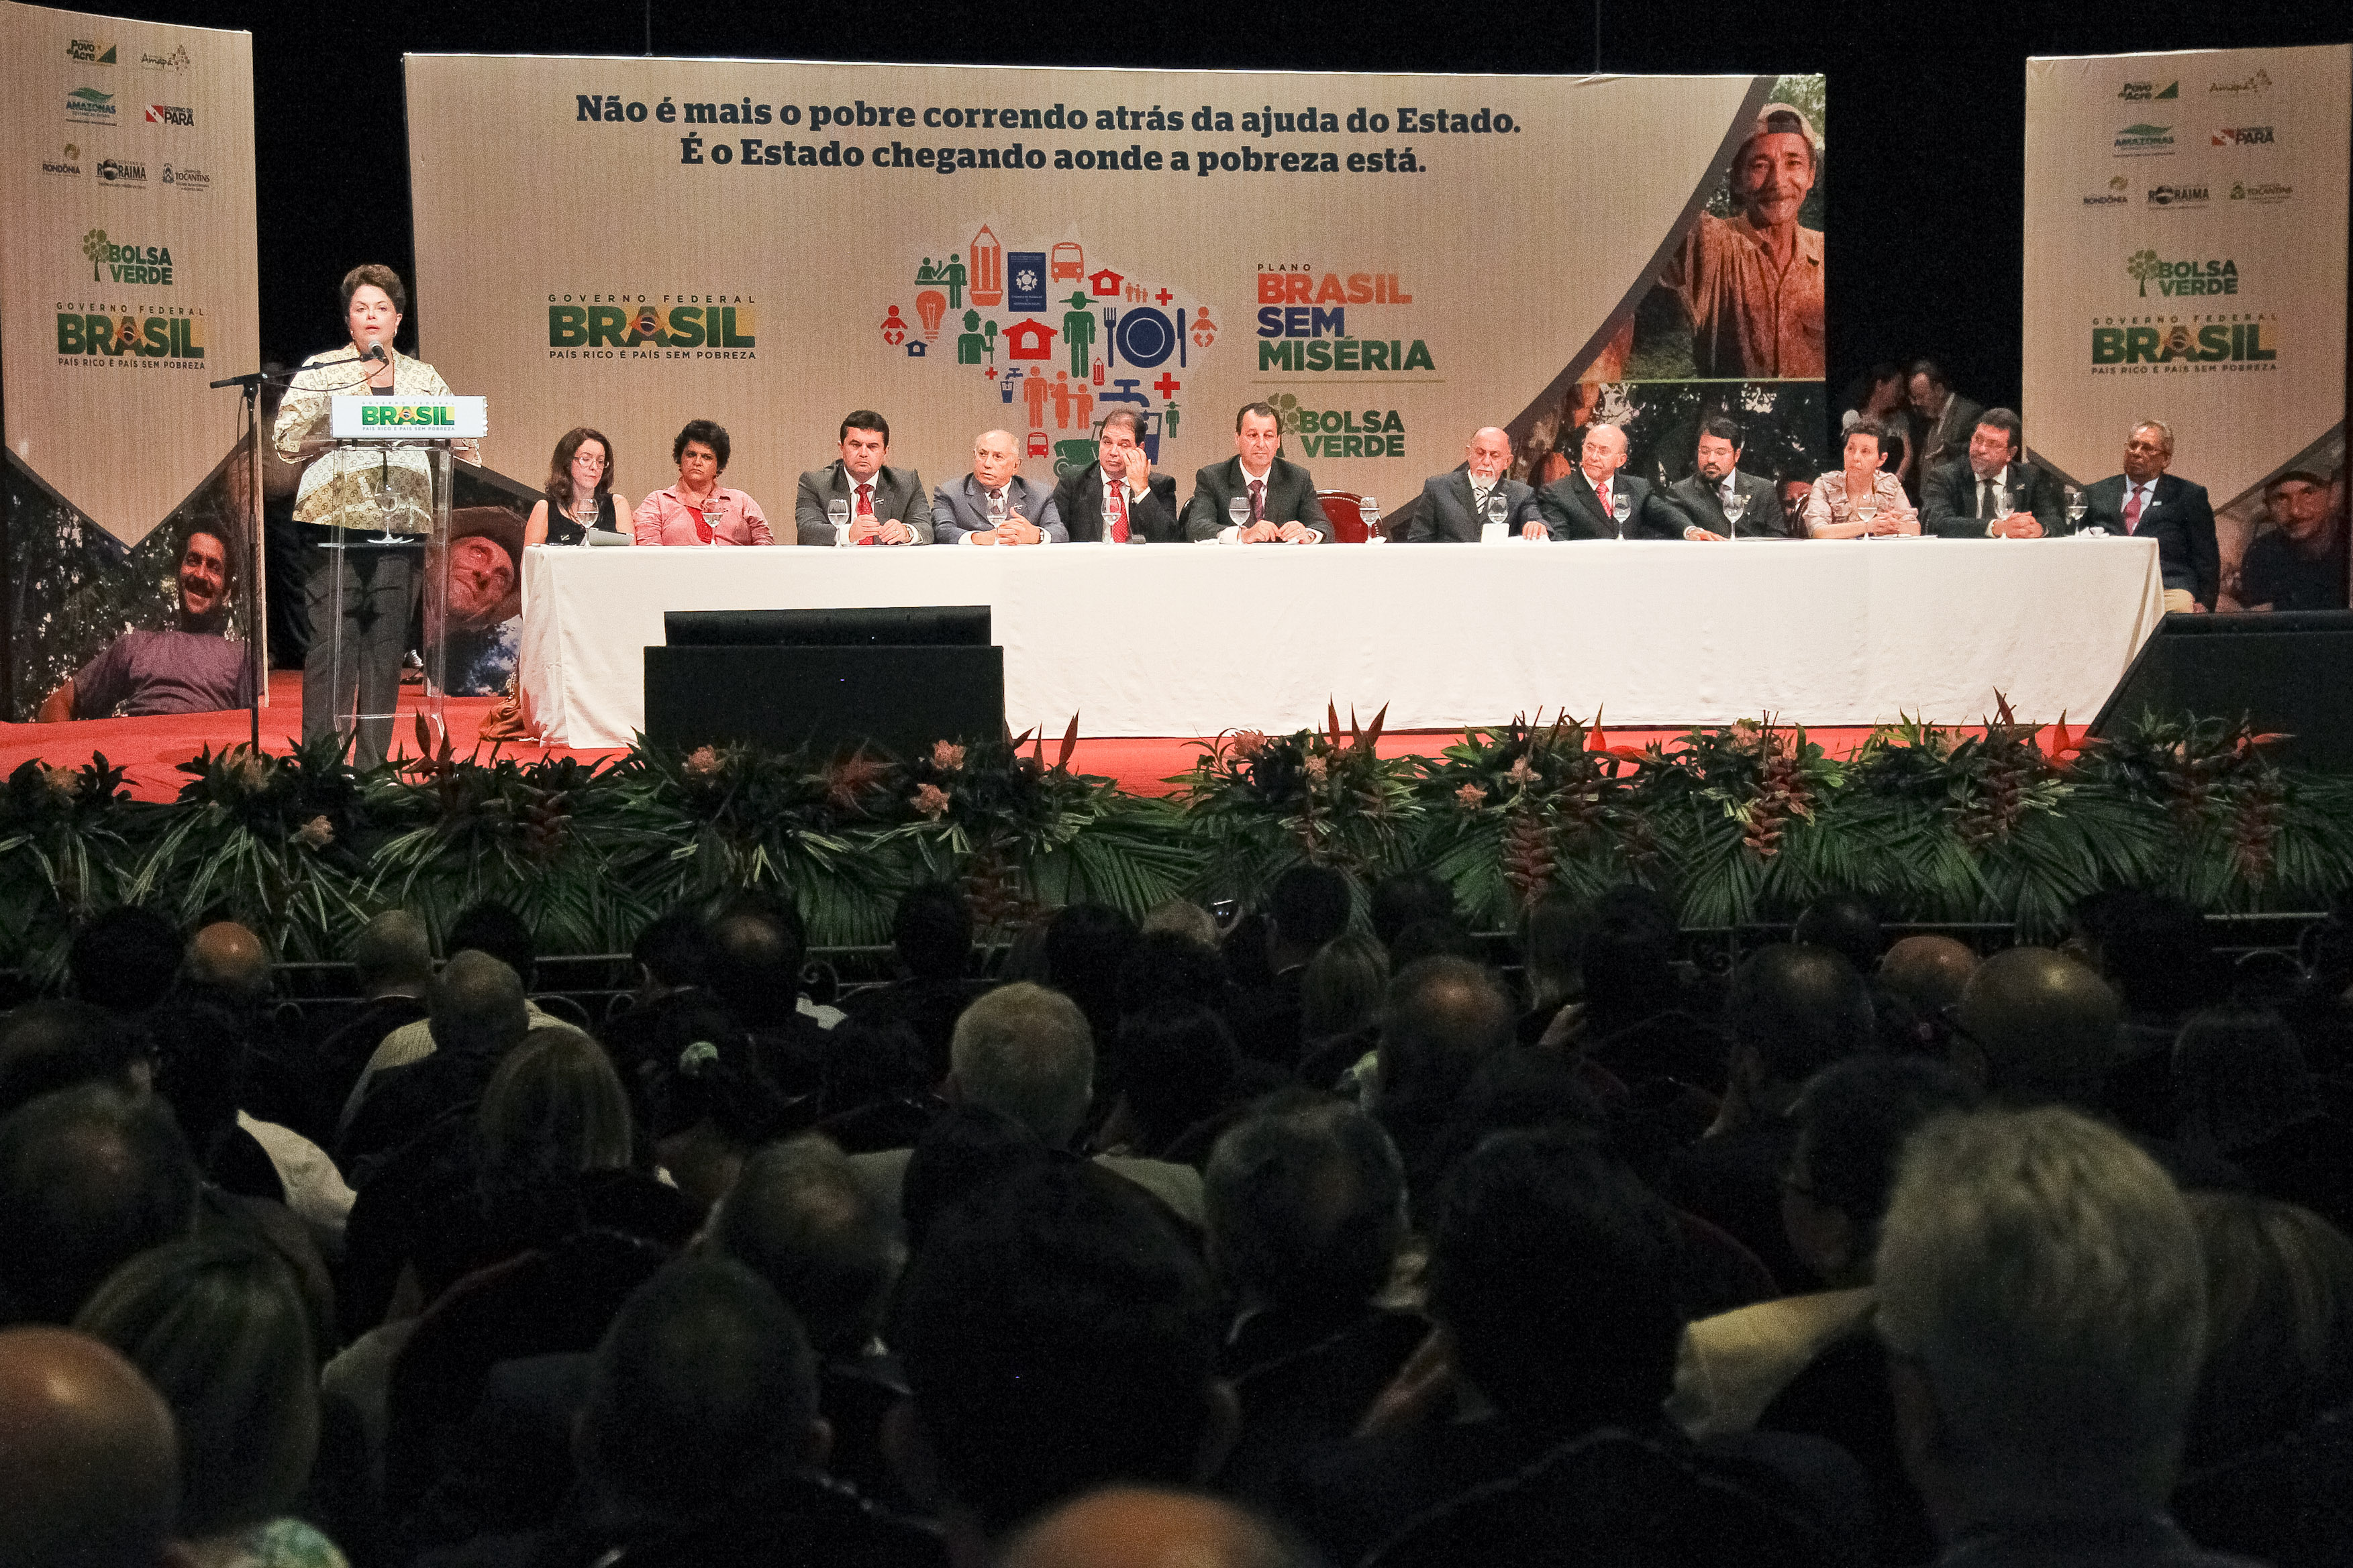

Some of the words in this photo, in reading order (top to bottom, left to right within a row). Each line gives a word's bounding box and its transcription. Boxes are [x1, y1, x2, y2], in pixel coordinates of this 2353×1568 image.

[71, 40, 95, 52] Povo
[72, 50, 95, 61] Acre
[576, 95, 648, 122] Não
[656, 97, 676, 122] é
[683, 97, 772, 125] mais
[780, 105, 801, 125] o
[809, 100, 915, 132] pobre
[923, 103, 1088, 130] correndo
[1095, 105, 1184, 131] atrás
[1191, 106, 1234, 132] da
[1242, 105, 1339, 138] ajuda
[1347, 107, 1389, 133] do
[1397, 107, 1521, 133] Estado.
[681, 132, 703, 164] É
[711, 144, 733, 164] o
[740, 139, 864, 166] Estado
[872, 142, 1046, 174] chegando
[1054, 144, 1163, 170] aonde
[1170, 150, 1190, 170] a
[1197, 146, 1339, 176] pobreza
[1347, 147, 1426, 172] está.
[175, 172, 210, 182] TOCANTINS
[109, 244, 172, 266] BOLSA
[109, 264, 172, 285] VERDE
[2158, 259, 2238, 278] BOLSA
[1258, 273, 1412, 304] BRASIL
[2158, 278, 2238, 297] VERDE
[56, 302, 127, 313] GOVERNO
[140, 305, 203, 316] FEDERAL
[548, 295, 646, 303] GOVERNO
[664, 295, 755, 303] FEDERAL
[549, 306, 756, 348] BRASIL
[1256, 306, 1345, 337] SEM
[2093, 315, 2178, 325] GOVERNO
[2194, 313, 2276, 323] FEDERAL
[57, 313, 204, 358] BRASIL
[2093, 324, 2276, 364] BRASIL
[550, 350, 577, 359] PAÍS
[583, 351, 613, 359] RICO
[620, 350, 626, 359] É
[633, 350, 660, 359] PAÍS
[666, 351, 690, 359] SEM
[697, 351, 756, 360] POBREZA
[1258, 335, 1436, 371] MISÉRIA
[58, 358, 79, 366] PAÍS
[83, 358, 105, 367] RICO
[119, 359, 138, 368] PAÍS
[142, 360, 159, 368] SEM
[164, 361, 205, 369] POBREZA
[2092, 366, 2116, 374] PAÍS
[2121, 366, 2148, 374] RICO
[2222, 364, 2276, 372] POBREZA
[362, 406, 455, 425] BRASIL
[1300, 410, 1405, 433] BOLSA
[1300, 435, 1405, 458] VERDE
